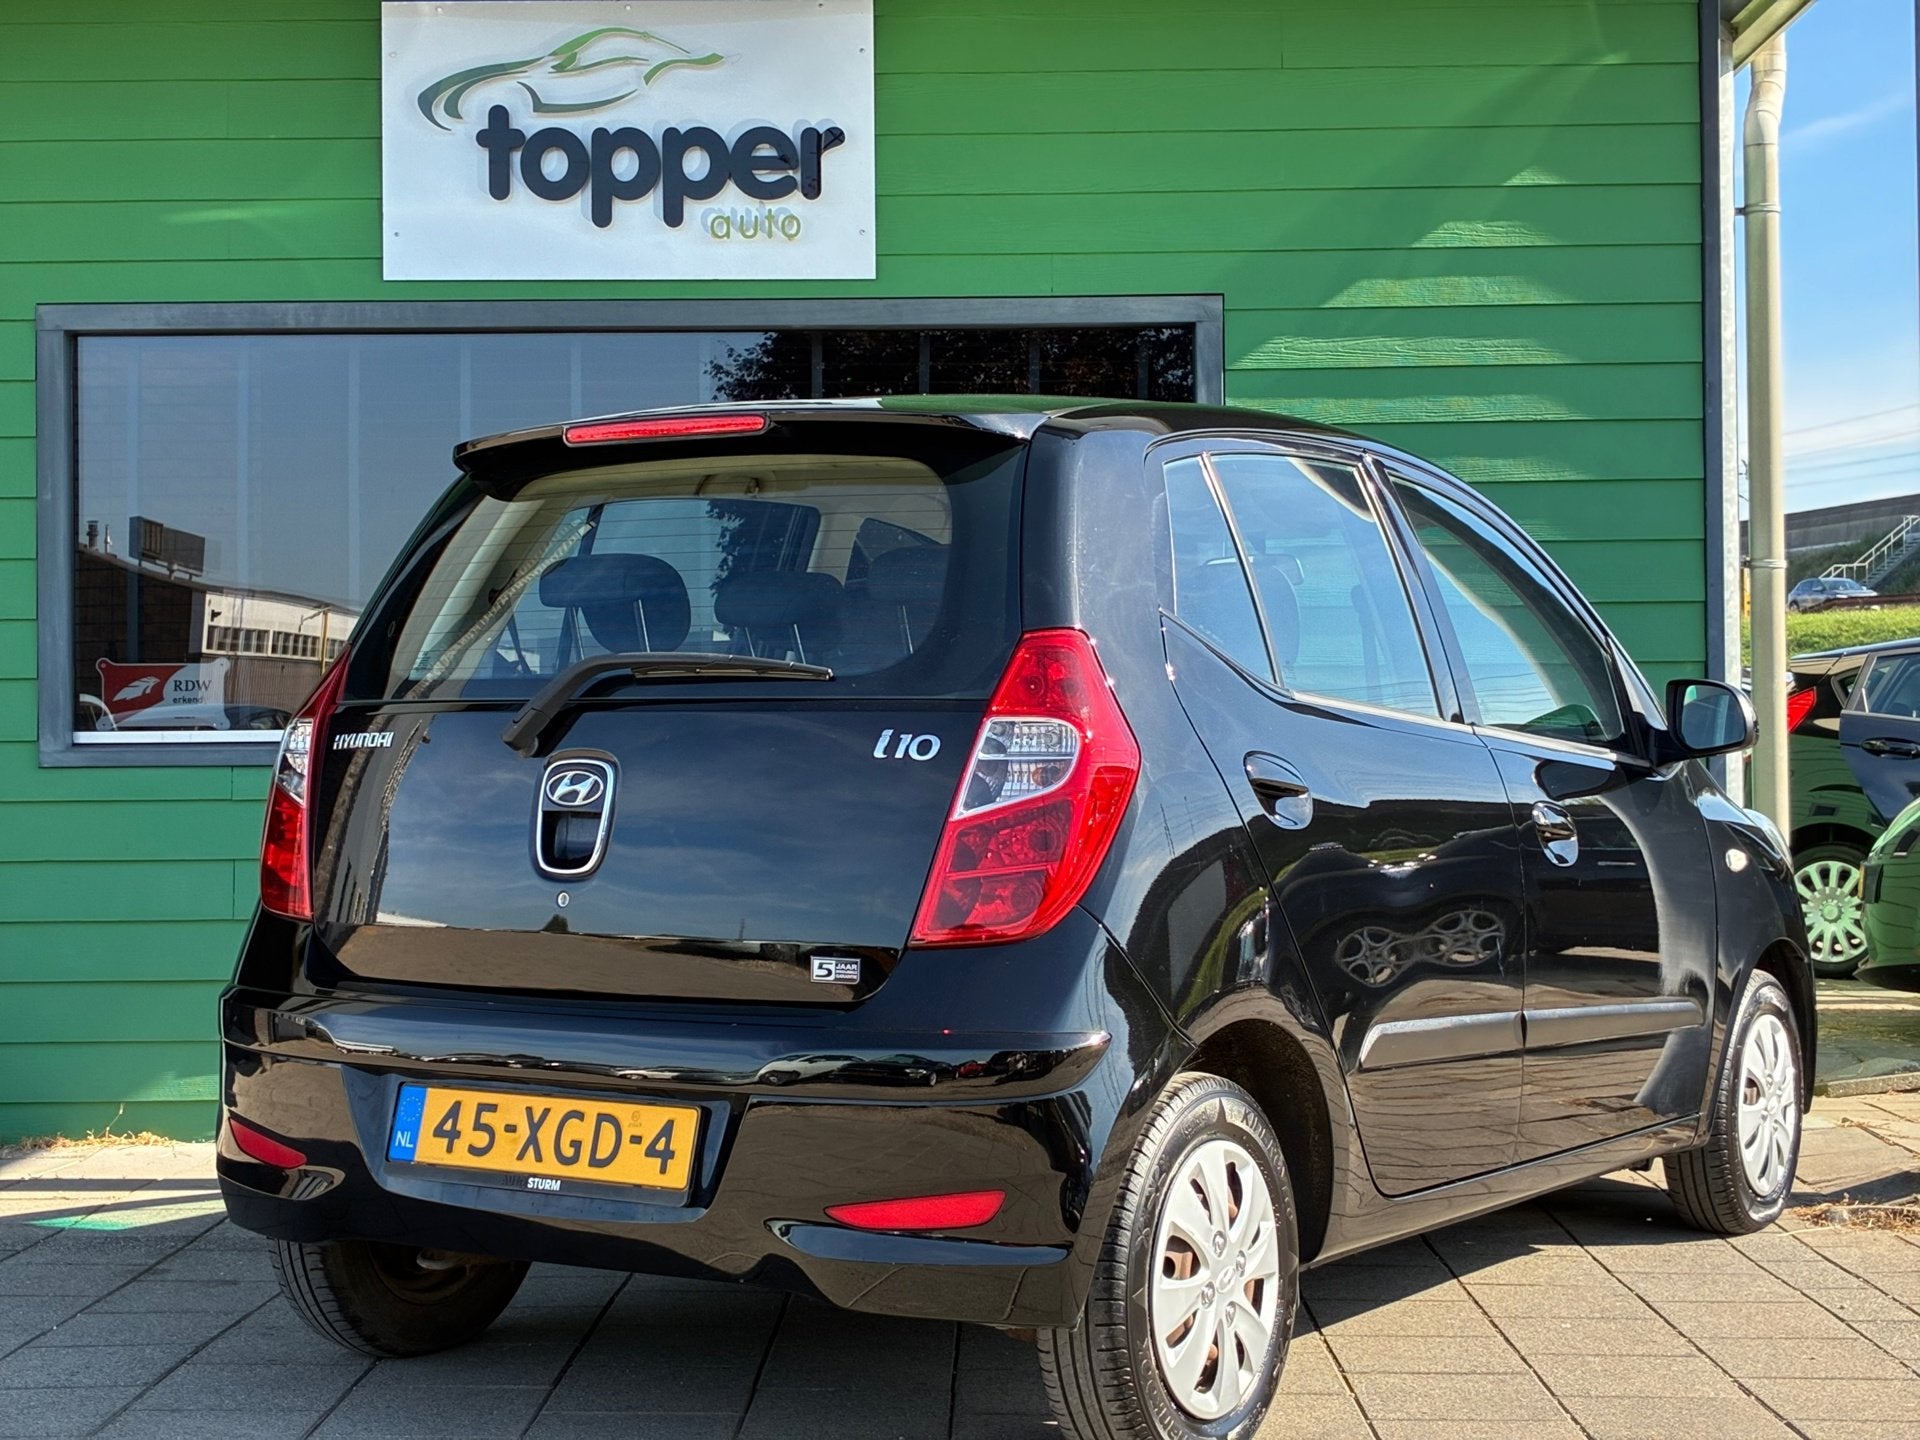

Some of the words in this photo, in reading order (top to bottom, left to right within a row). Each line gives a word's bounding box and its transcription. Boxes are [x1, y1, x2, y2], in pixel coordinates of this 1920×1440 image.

[476, 104, 846, 229] topper
[709, 208, 801, 241] auto
[173, 679, 212, 692] RDW
[332, 731, 395, 750] HYUNDAI
[873, 728, 941, 761] i10
[815, 961, 833, 978] 5
[395, 1130, 414, 1149] NL
[432, 1100, 676, 1176] 45-XGD-4
[527, 1176, 562, 1191] STURM
